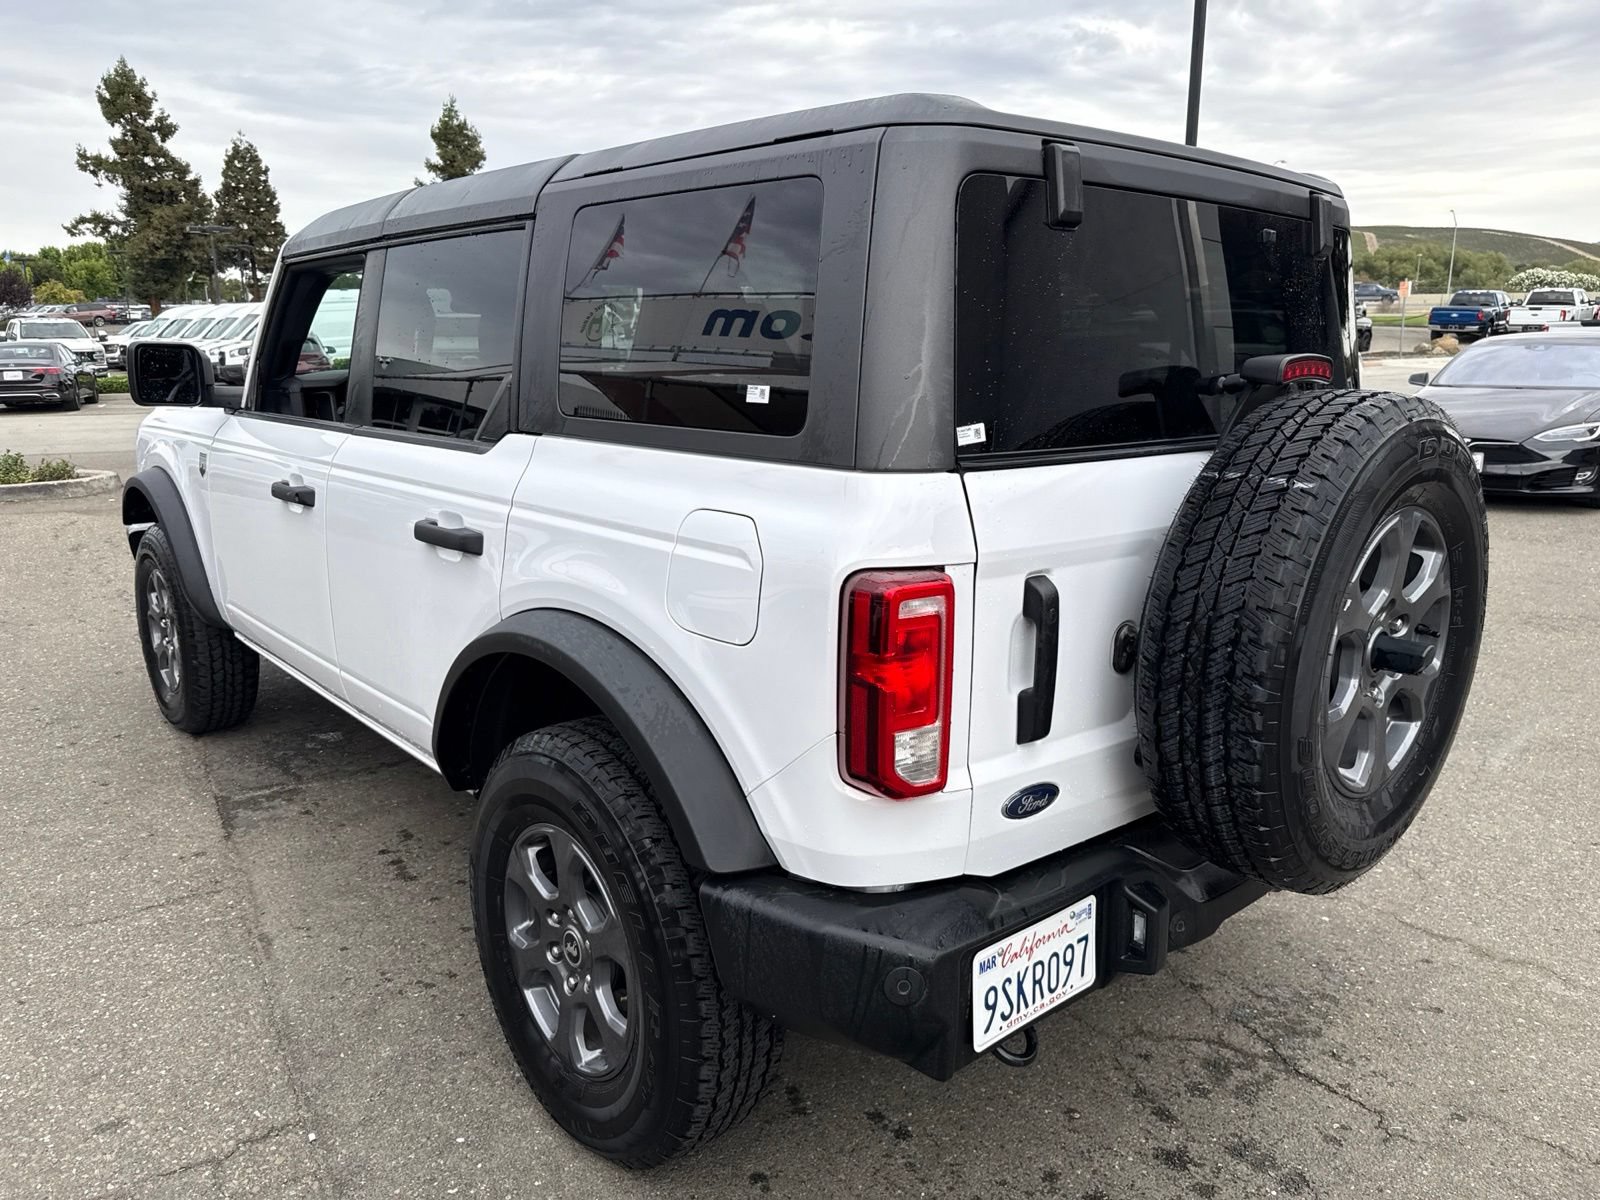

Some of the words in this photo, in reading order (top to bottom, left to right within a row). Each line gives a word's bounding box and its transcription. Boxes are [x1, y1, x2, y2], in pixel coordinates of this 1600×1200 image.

[979, 955, 997, 975] MAR
[1001, 920, 1076, 968] California
[984, 933, 1089, 1035] 9SKR097
[1007, 989, 1068, 1029] dmv.ca.gov
